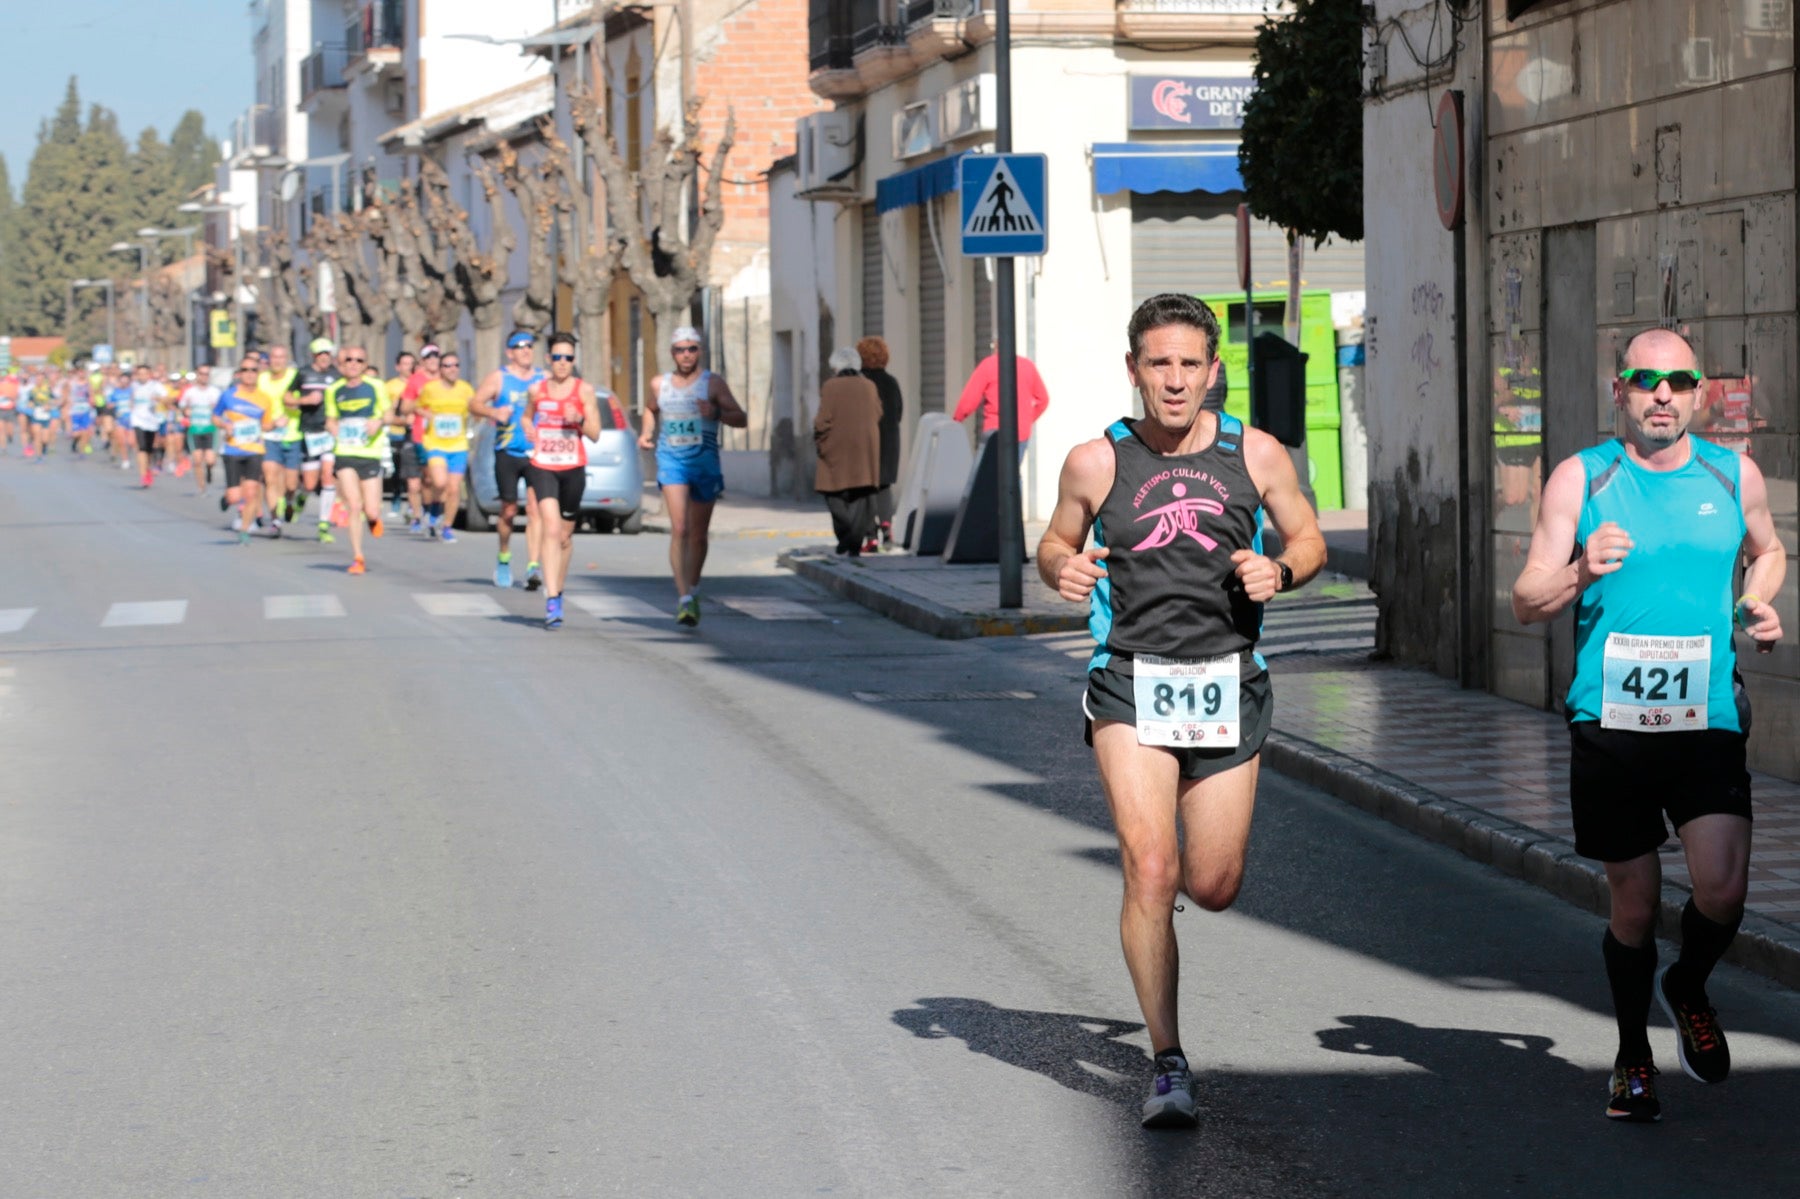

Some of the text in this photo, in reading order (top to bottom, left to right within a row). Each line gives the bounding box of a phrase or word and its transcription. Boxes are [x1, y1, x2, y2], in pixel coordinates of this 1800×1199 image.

[1209, 102, 1233, 116] DE
[669, 421, 695, 434] 514
[541, 440, 575, 453] 2290
[1133, 468, 1230, 509] ATLETISMO CULLAR VEGA
[1631, 639, 1649, 648] GRAN
[1650, 639, 1675, 649] PREMIO
[1676, 640, 1684, 649] DE
[1686, 638, 1705, 649] FONDO
[1621, 666, 1689, 701] 421
[1153, 682, 1222, 716] 819
